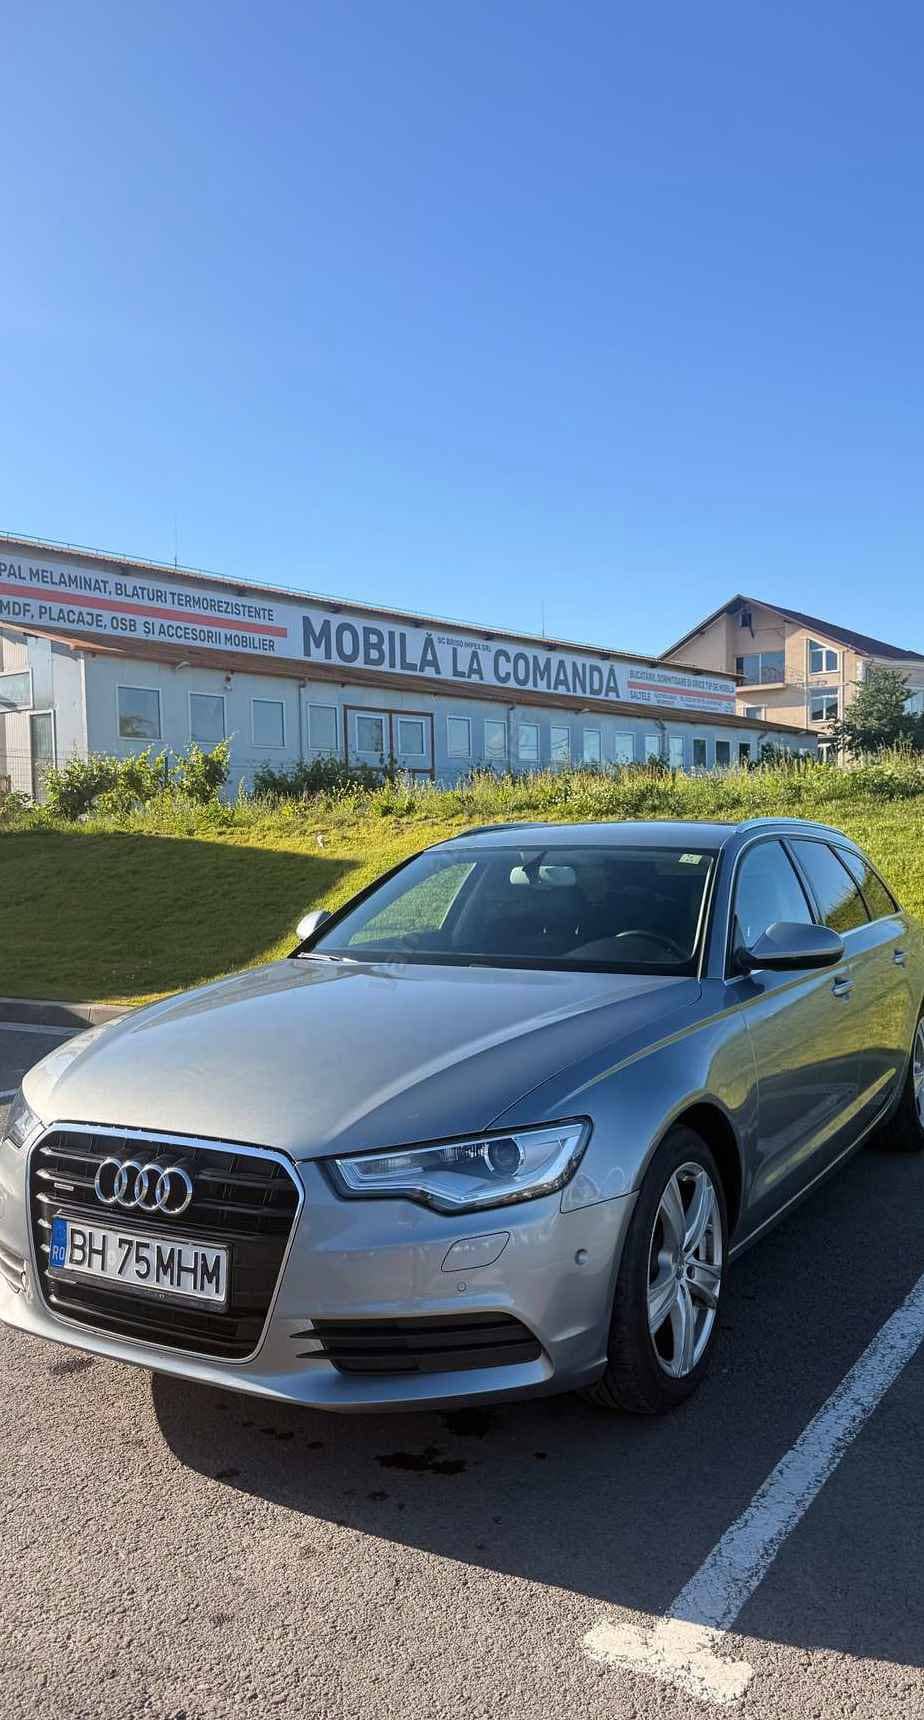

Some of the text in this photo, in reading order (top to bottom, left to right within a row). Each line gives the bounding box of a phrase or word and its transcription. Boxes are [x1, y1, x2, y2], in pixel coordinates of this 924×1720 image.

[29, 567, 112, 596] MELAMINAT,
[114, 582, 167, 603] BLATURI
[169, 591, 274, 621] TERMOREZISTENTE
[0, 600, 34, 619] MDF,
[38, 605, 107, 630] PLACAJE,
[110, 616, 137, 632] OSB
[158, 624, 221, 645] ACCESORII
[224, 632, 275, 651] MOBILIER
[302, 615, 620, 699] MOBILĂ LA COMANDĂ
[52, 1246, 65, 1261] RO
[69, 1228, 106, 1271] BH
